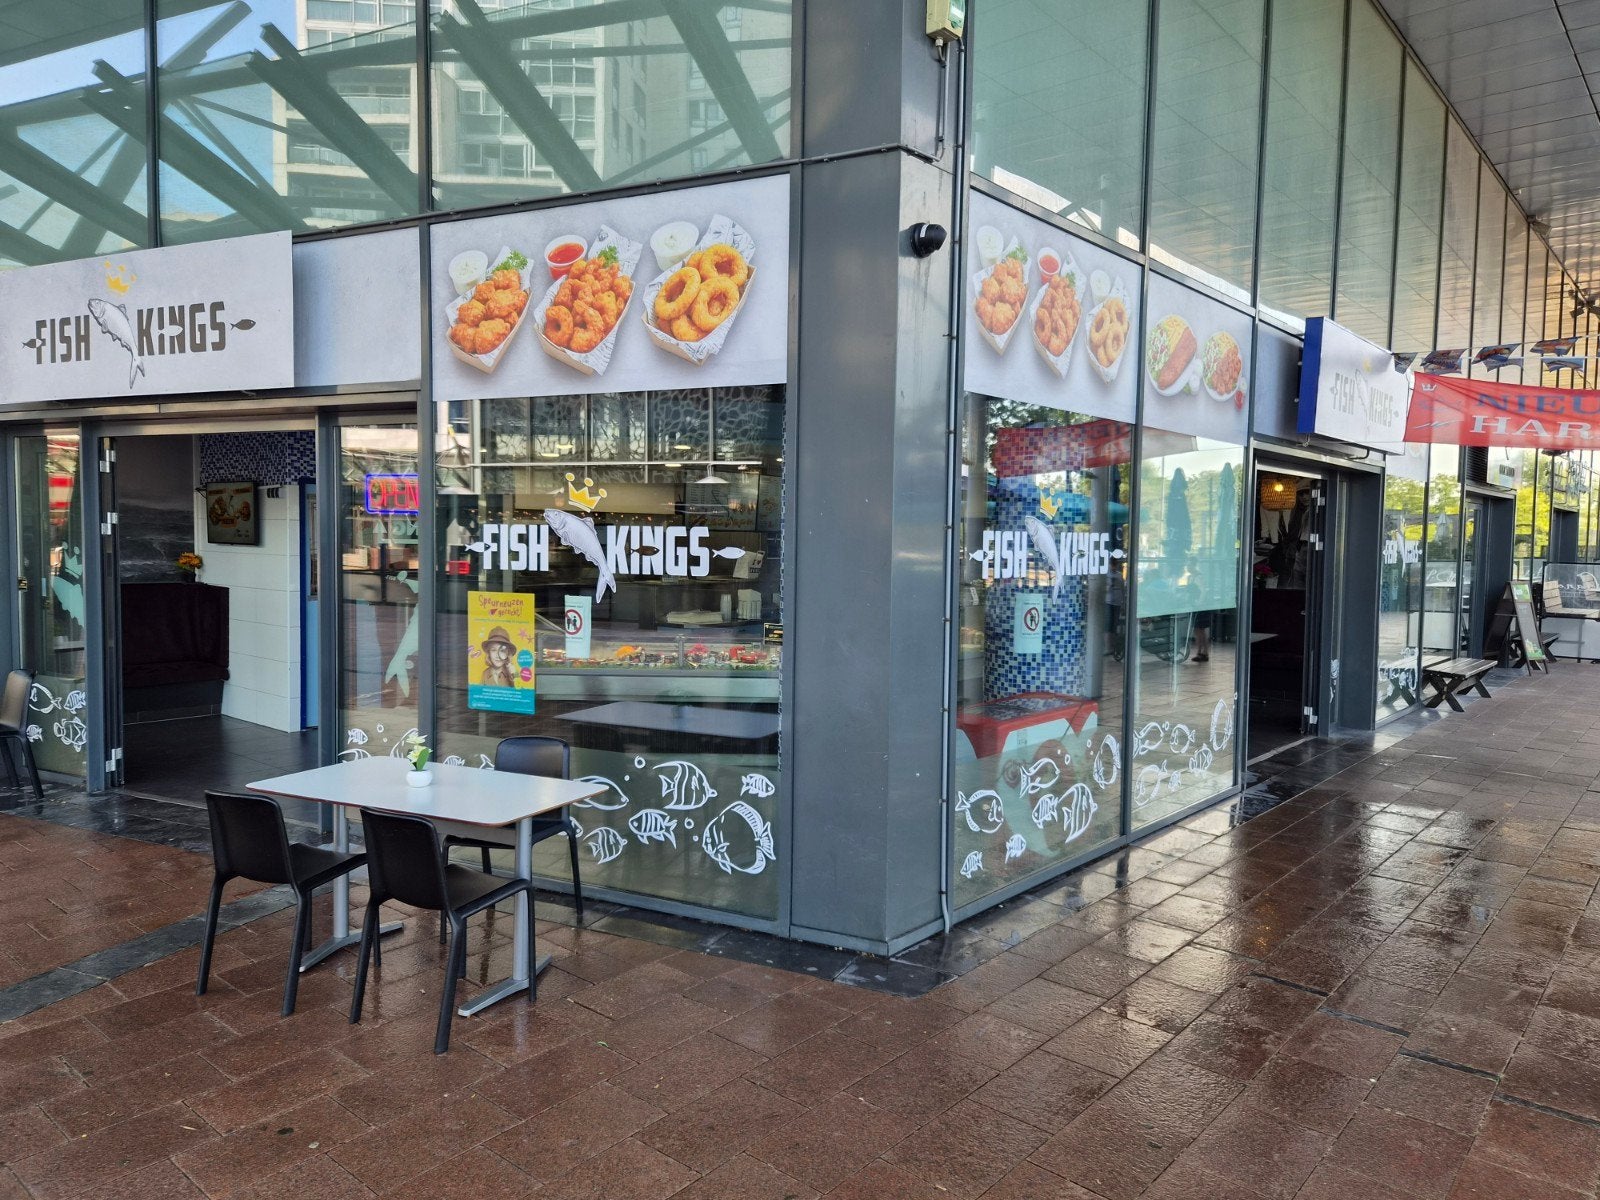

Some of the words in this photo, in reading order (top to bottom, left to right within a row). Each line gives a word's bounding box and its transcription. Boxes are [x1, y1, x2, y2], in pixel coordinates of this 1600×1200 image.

[36, 315, 90, 365] FISH
[137, 301, 227, 356] KINGS
[1333, 372, 1355, 415] FISH
[370, 478, 419, 509] OPEN
[483, 523, 549, 571] FISH
[606, 525, 709, 577] KINGS
[982, 530, 1027, 579] FISH
[1060, 531, 1110, 576] KINGS
[479, 594, 524, 609] Speurneuzen
